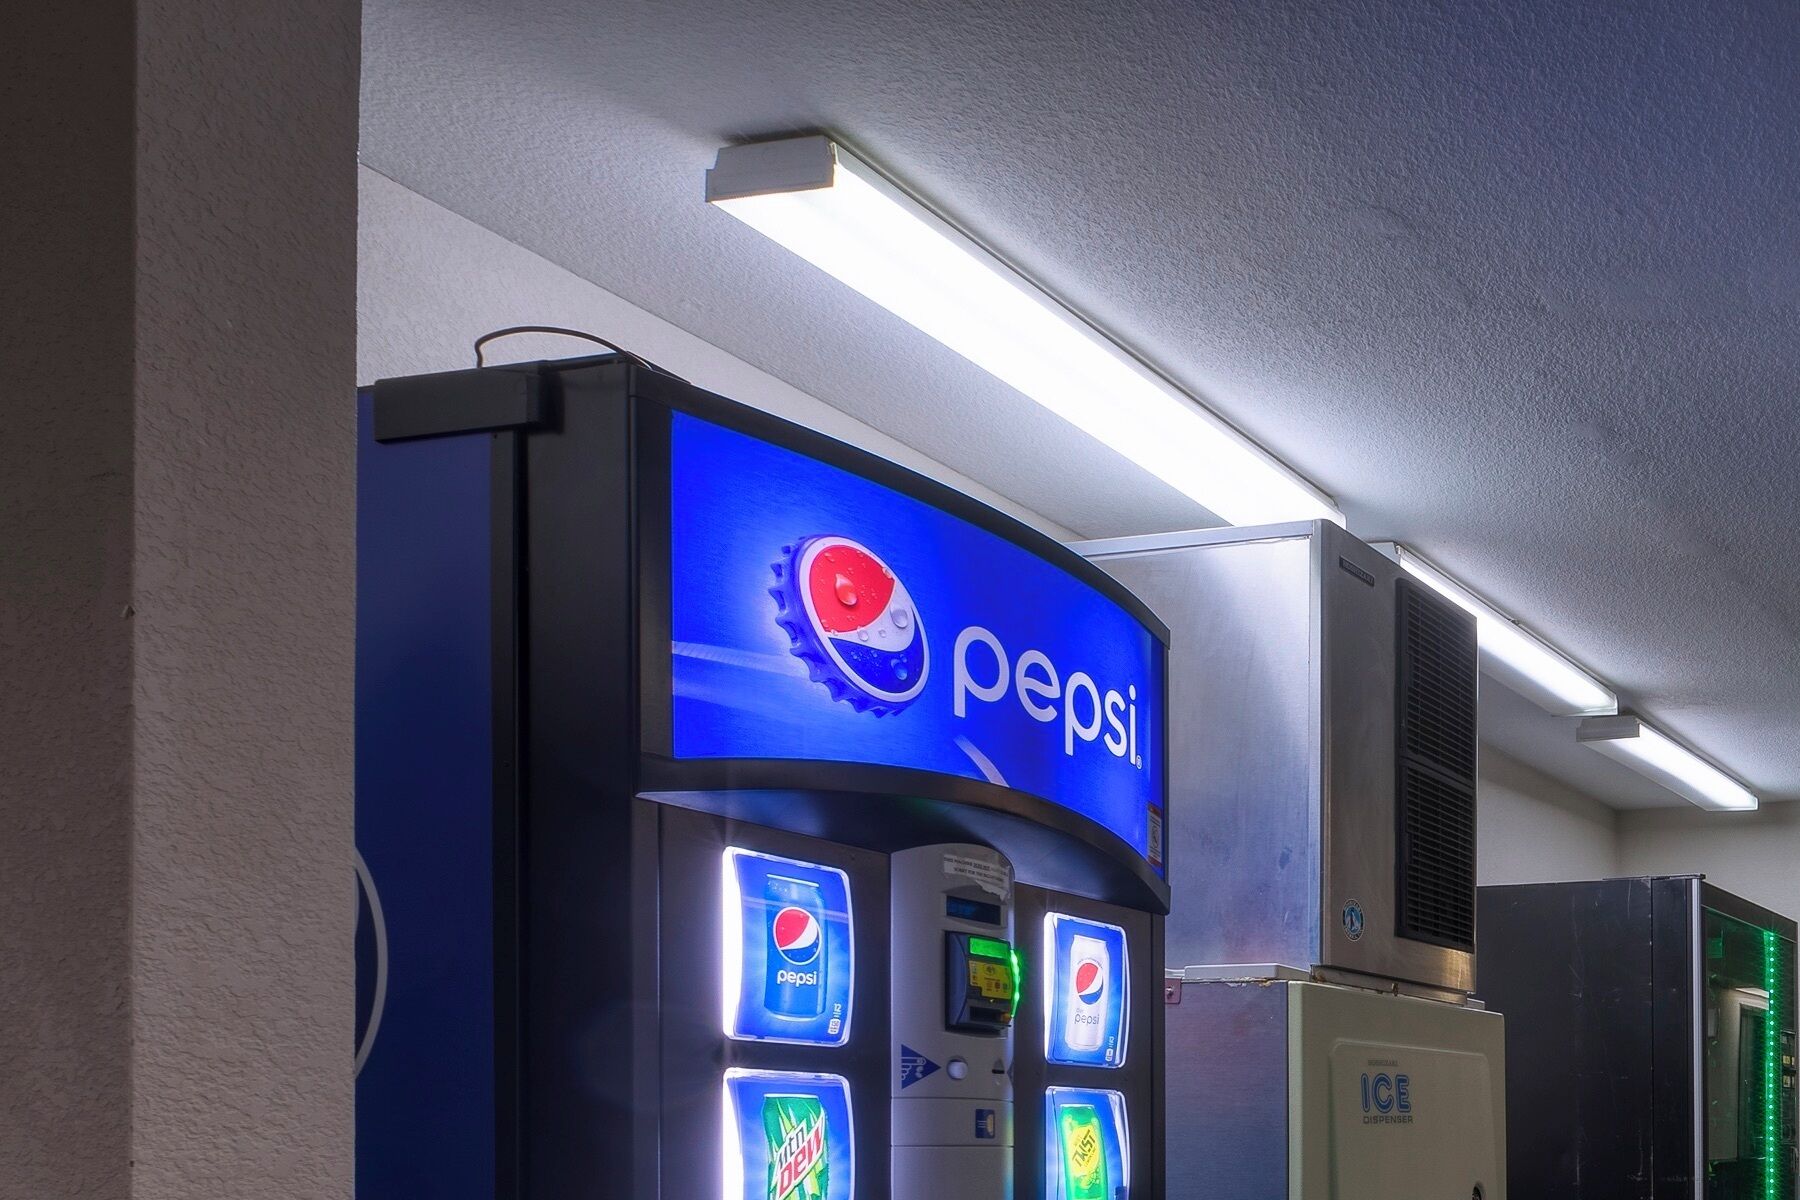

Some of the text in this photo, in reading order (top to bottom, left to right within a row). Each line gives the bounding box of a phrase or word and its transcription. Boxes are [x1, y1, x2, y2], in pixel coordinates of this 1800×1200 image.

[953, 626, 1137, 766] pepsi
[776, 969, 817, 987] pepsi
[1074, 1013, 1100, 1026] pepsi
[1361, 1073, 1411, 1113] ICE
[1363, 1115, 1414, 1124] DISPENSER
